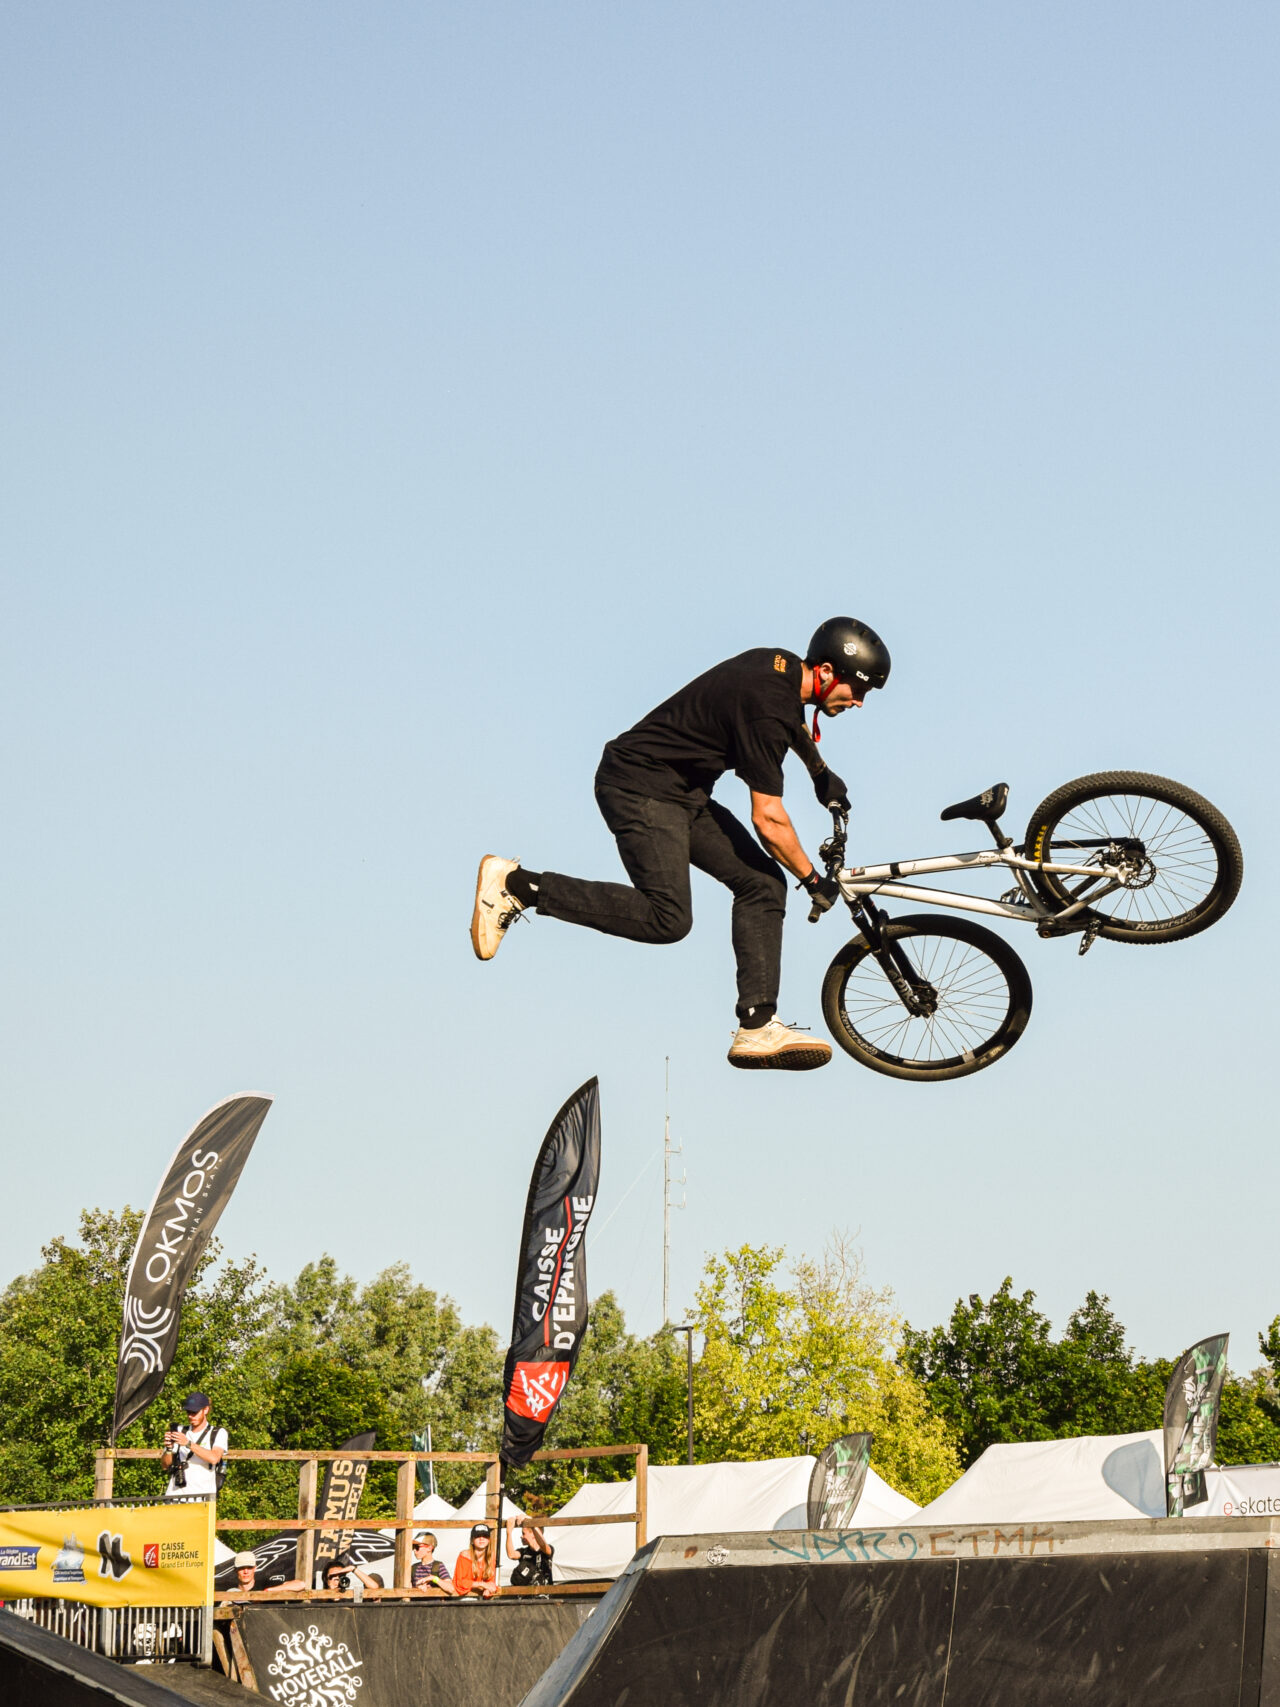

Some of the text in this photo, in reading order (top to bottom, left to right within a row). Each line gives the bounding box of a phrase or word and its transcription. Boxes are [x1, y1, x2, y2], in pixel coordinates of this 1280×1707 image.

[146, 1149, 219, 1283] OKMOS
[531, 1227, 565, 1322] CAISSE
[161, 1542, 185, 1551] CAISSE
[315, 1460, 354, 1561] FAMUS
[161, 1551, 199, 1560] D'EPARGNE
[269, 1651, 363, 1701] HOVERALL
